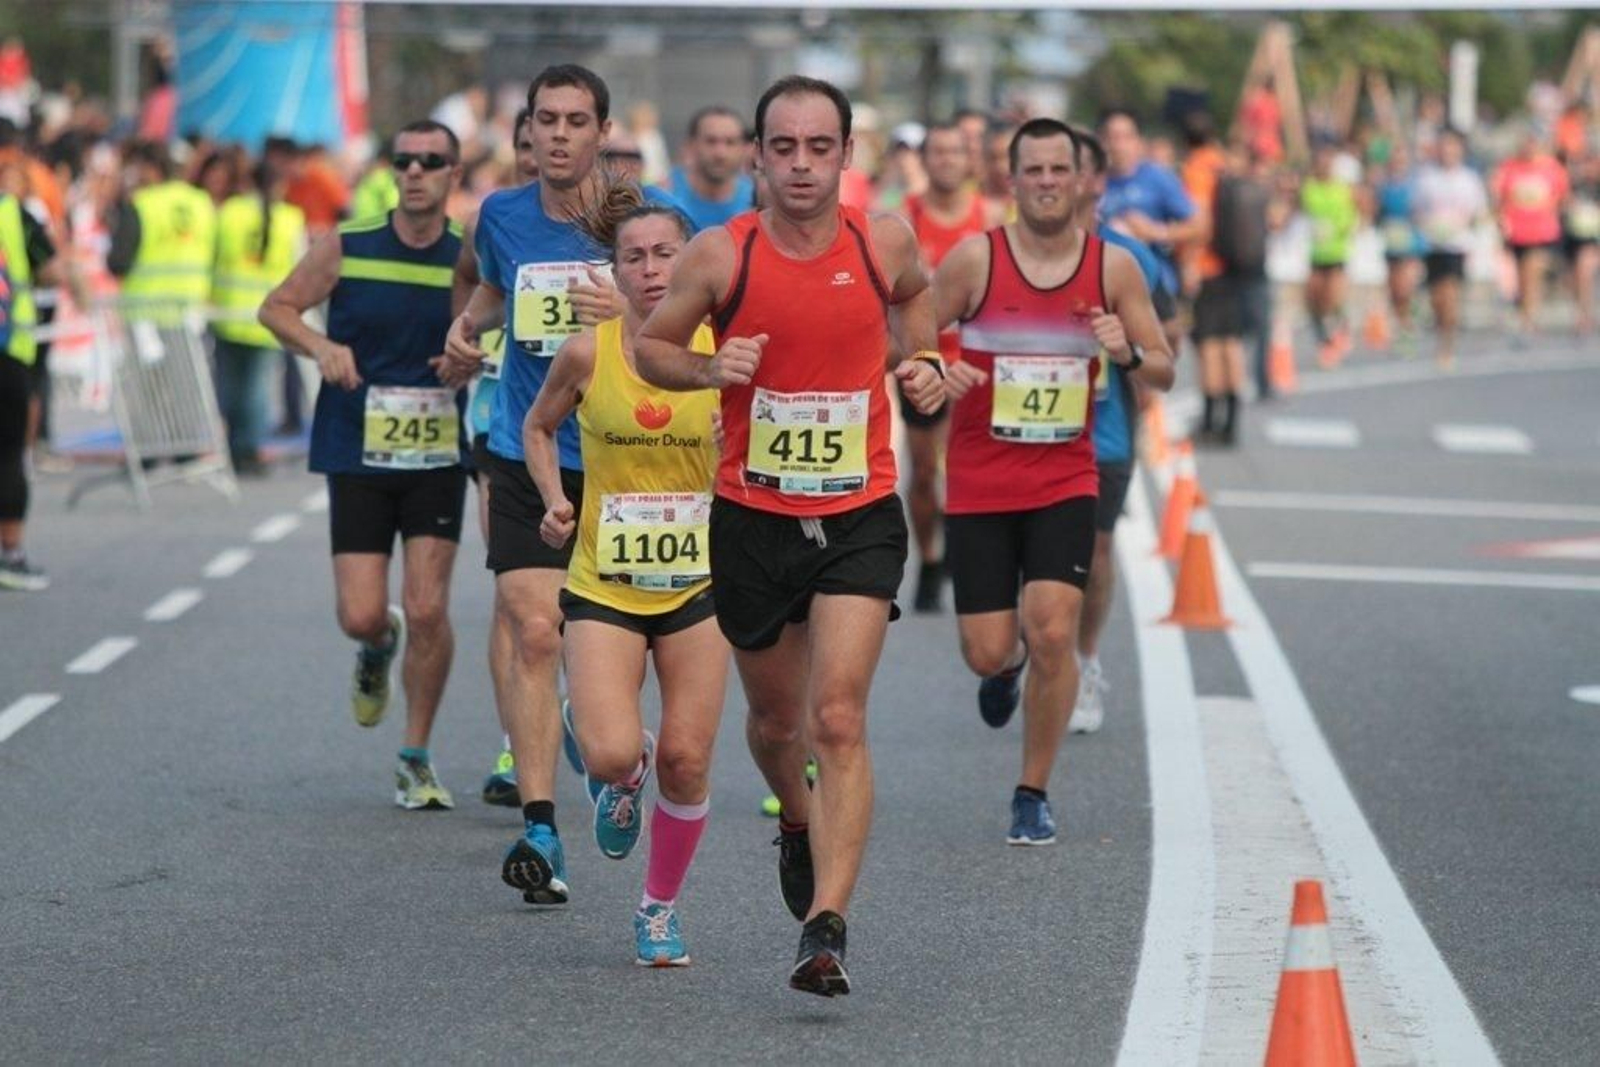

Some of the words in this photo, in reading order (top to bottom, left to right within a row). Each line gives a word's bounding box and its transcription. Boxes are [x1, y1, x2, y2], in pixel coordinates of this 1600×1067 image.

[1022, 388, 1061, 415] 47
[384, 416, 440, 443] 245
[604, 431, 660, 447] Saunier
[662, 433, 702, 449] Duval
[768, 428, 843, 464] 415
[611, 531, 700, 564] 1104
